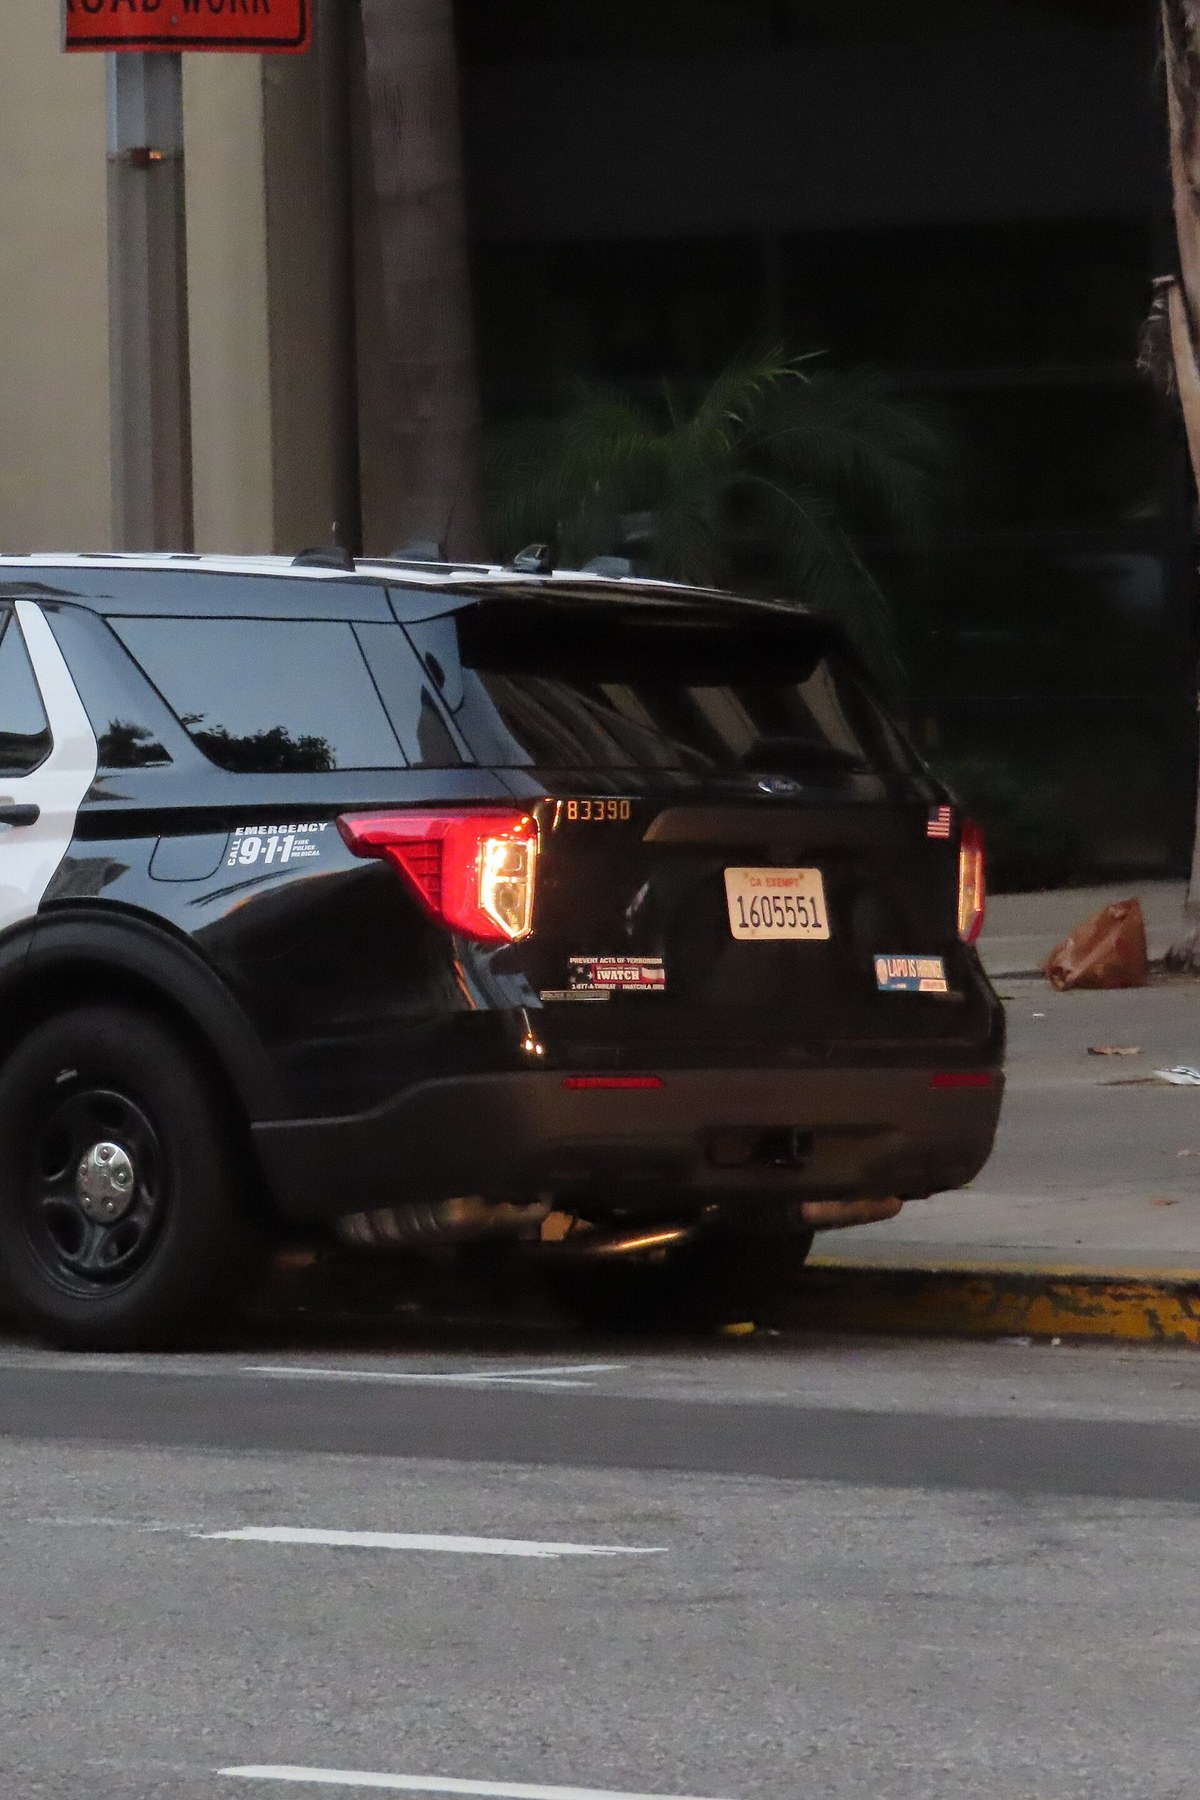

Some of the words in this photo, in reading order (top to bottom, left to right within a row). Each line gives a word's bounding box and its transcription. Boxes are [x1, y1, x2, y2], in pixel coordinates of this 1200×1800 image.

[567, 800, 630, 820] 83390
[234, 822, 329, 836] EMERGENCY
[227, 838, 242, 866] CALL
[750, 878, 761, 887] CA
[766, 878, 800, 888] EXEMPT
[736, 895, 822, 928] 1605551
[596, 970, 640, 980] iWATCH
